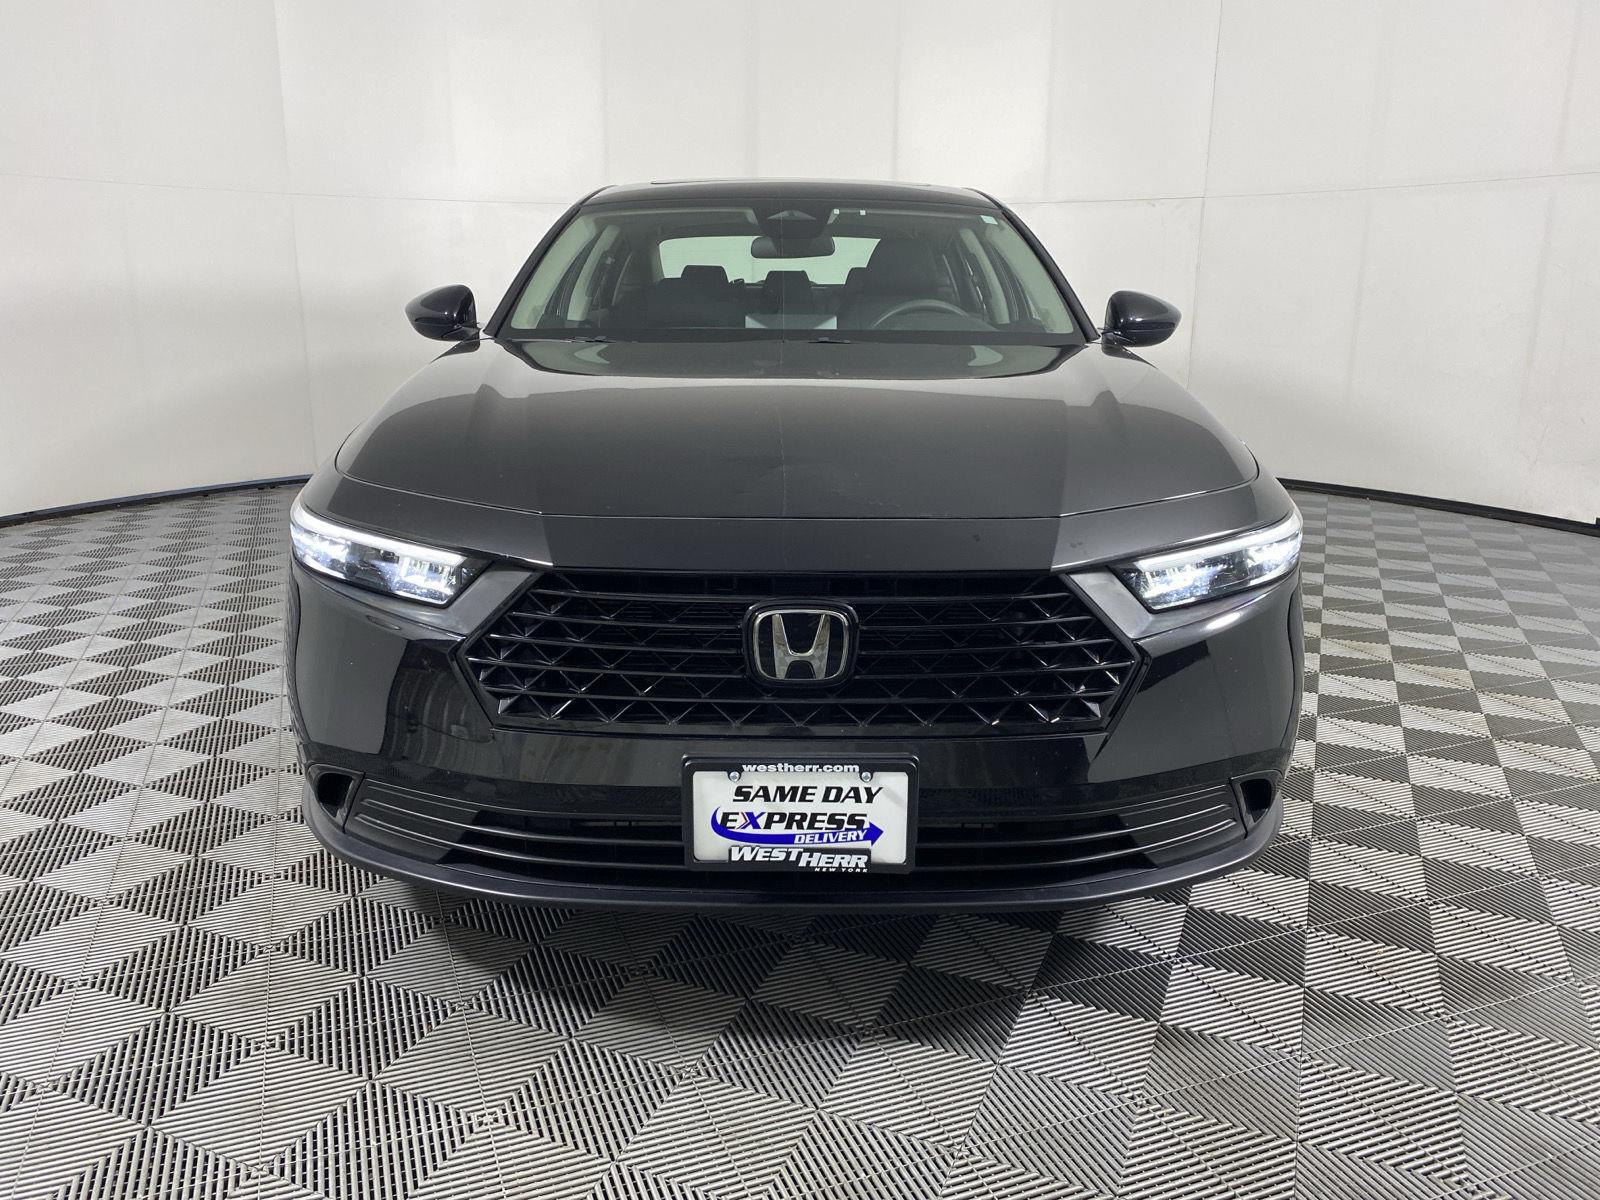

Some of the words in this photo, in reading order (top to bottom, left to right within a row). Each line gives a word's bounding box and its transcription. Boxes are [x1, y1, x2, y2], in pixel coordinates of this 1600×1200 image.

[742, 762, 860, 773] westherr.com
[732, 785, 818, 803] SAME
[820, 786, 884, 804] DAY
[719, 811, 867, 831] EXPRESS
[793, 829, 868, 845] DELIVERY
[731, 846, 804, 862] WEST
[798, 852, 868, 868] HERR
